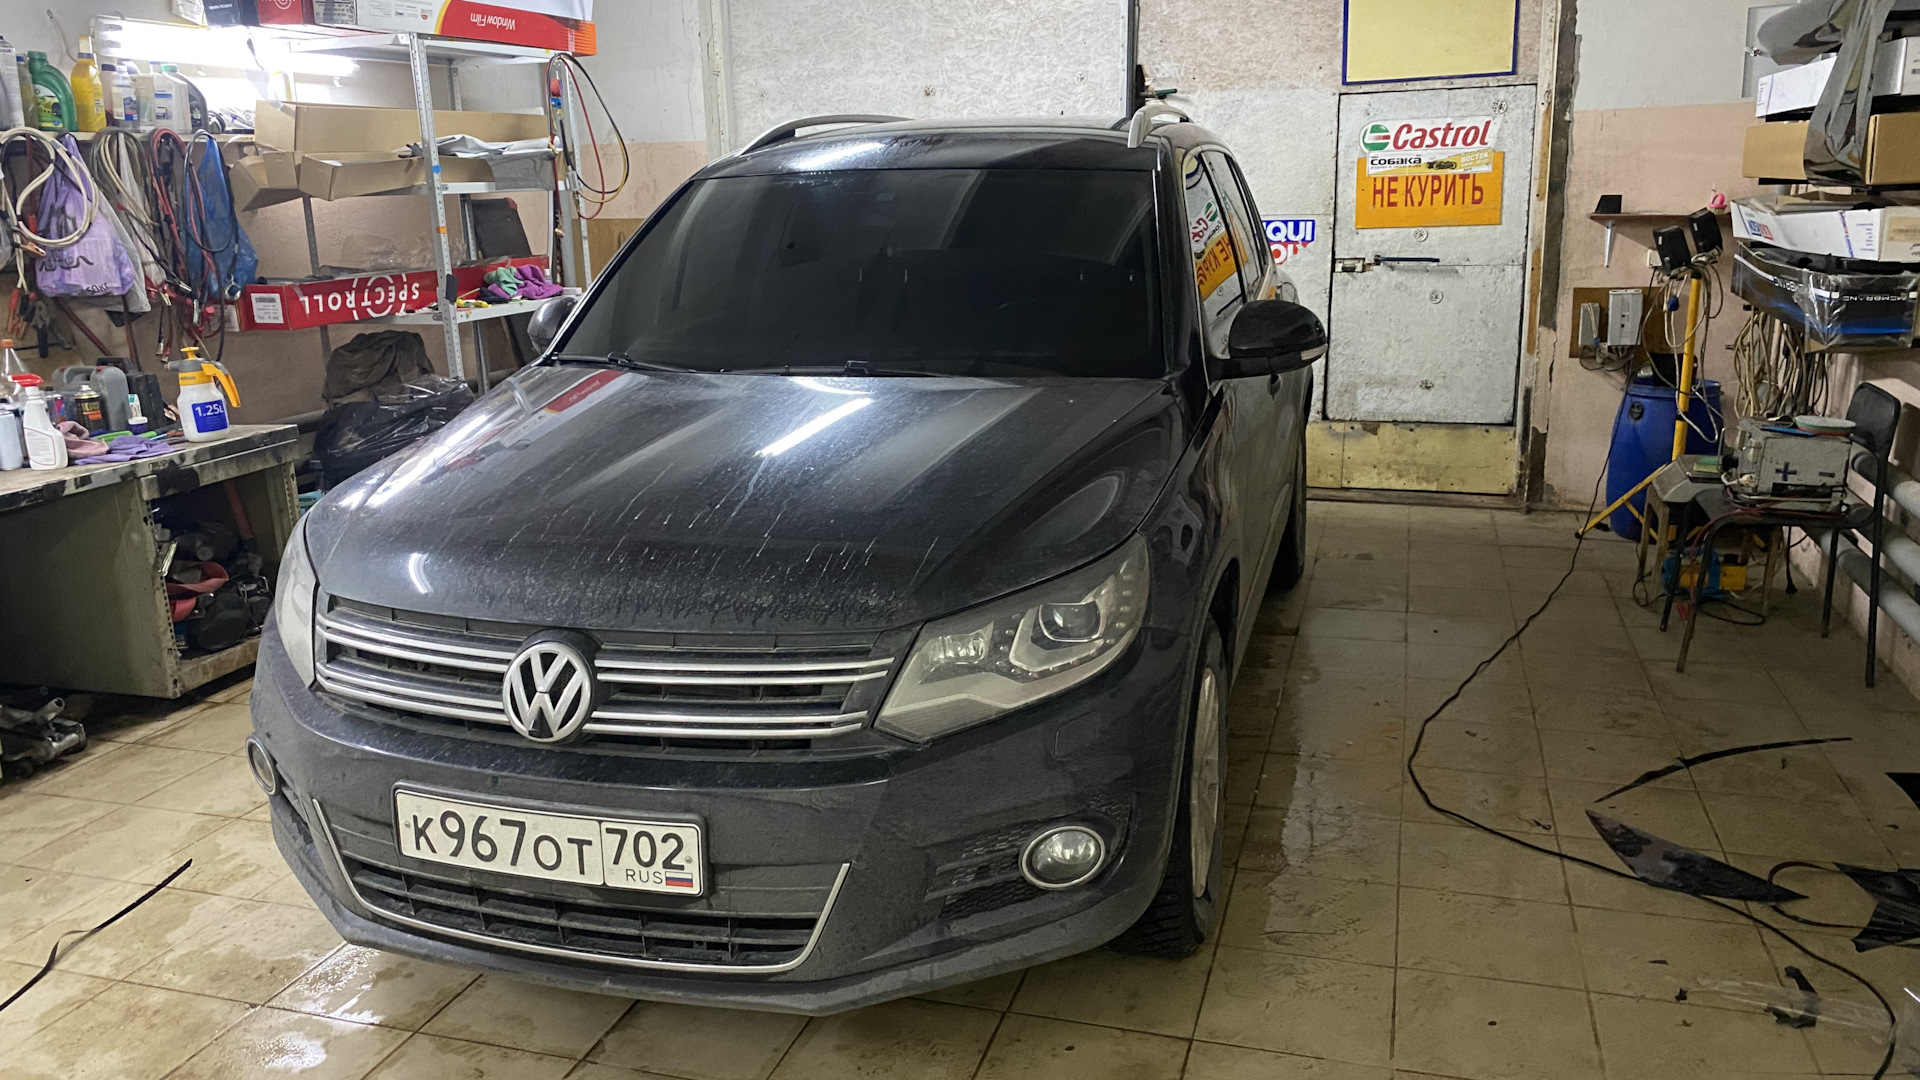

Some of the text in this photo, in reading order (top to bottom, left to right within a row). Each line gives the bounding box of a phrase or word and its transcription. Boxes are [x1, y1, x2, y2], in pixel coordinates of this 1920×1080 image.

[470, 12, 516, 30] Window Film
[1393, 120, 1492, 150] Castrol
[1372, 173, 1484, 208] НЕ КУРИТЬ
[1262, 220, 1313, 243] QUI
[300, 282, 420, 315] SPECTROLL
[605, 827, 685, 871] 702
[625, 868, 663, 885] RUS
